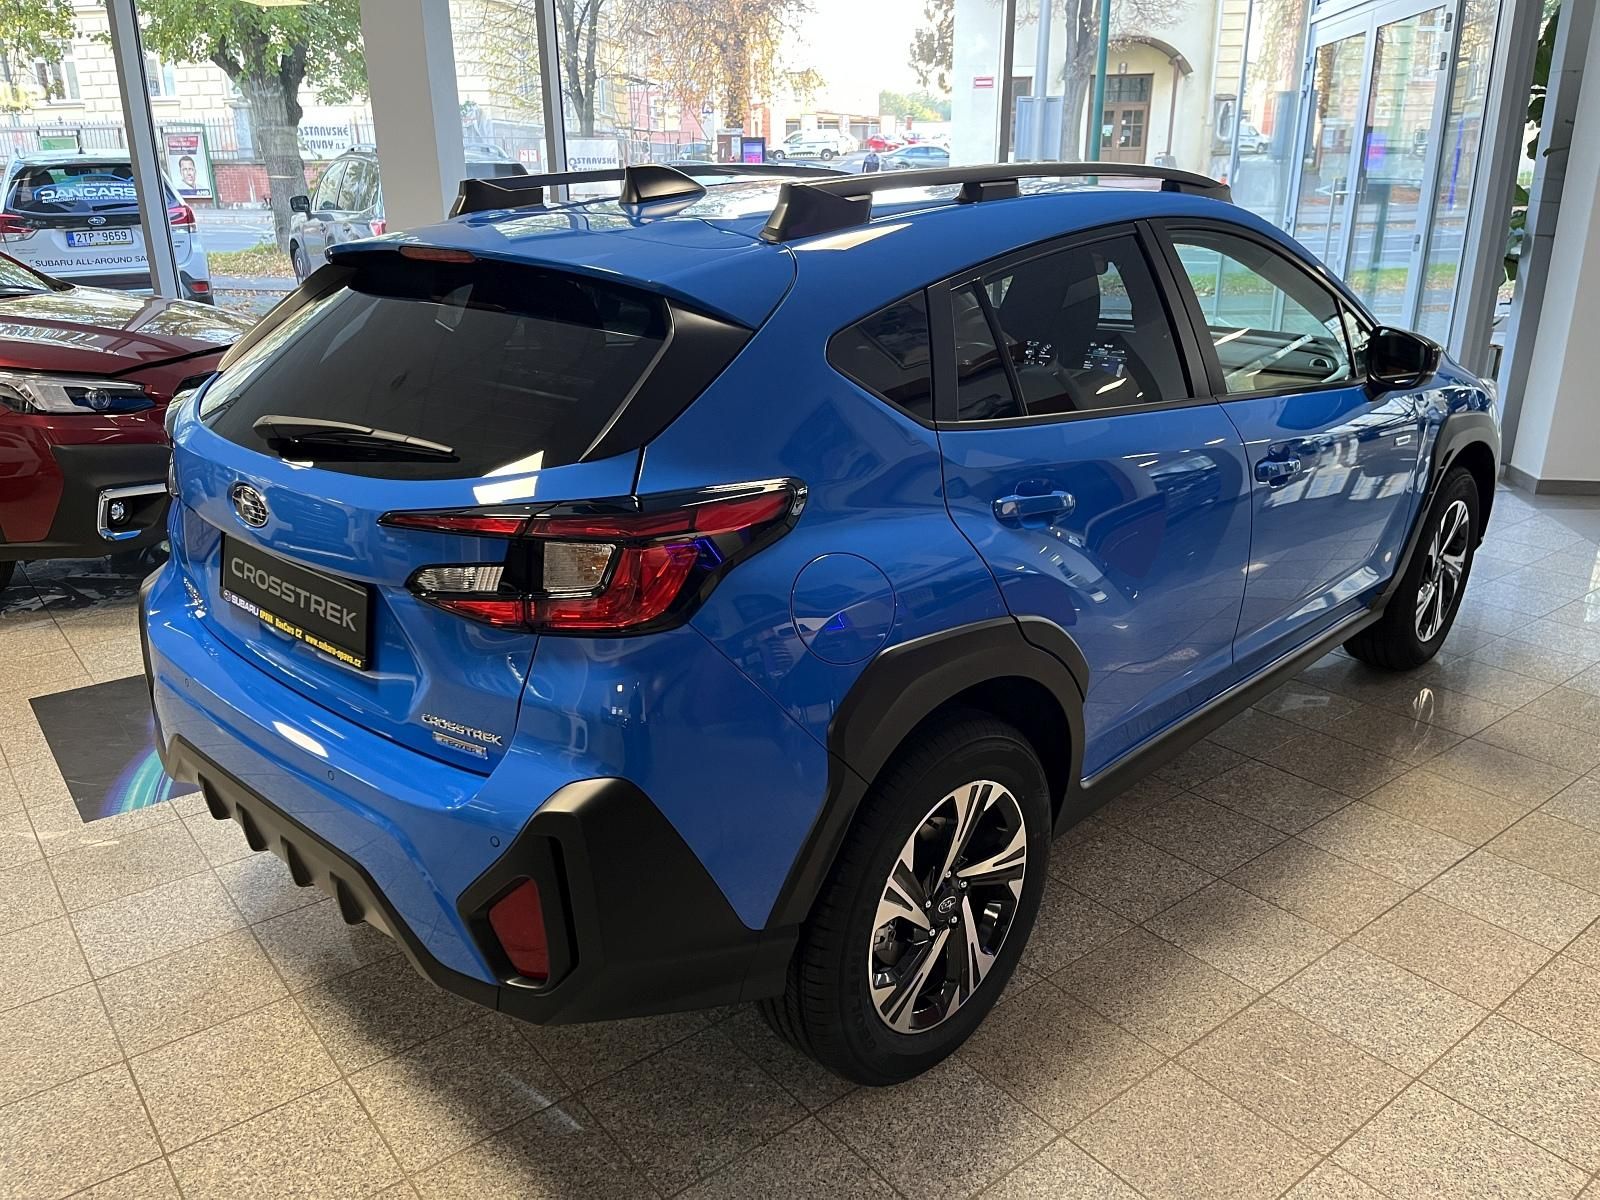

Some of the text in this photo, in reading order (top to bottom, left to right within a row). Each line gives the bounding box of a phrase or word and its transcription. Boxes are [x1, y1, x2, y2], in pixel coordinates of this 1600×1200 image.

[75, 232, 95, 243] 2TP
[102, 230, 127, 241] 9659
[35, 254, 147, 267] SUBARU ALL-AROUND SA
[231, 556, 358, 633] CROSSTREK
[231, 594, 259, 617] SUBARU
[421, 713, 503, 747] CROSSTREK
